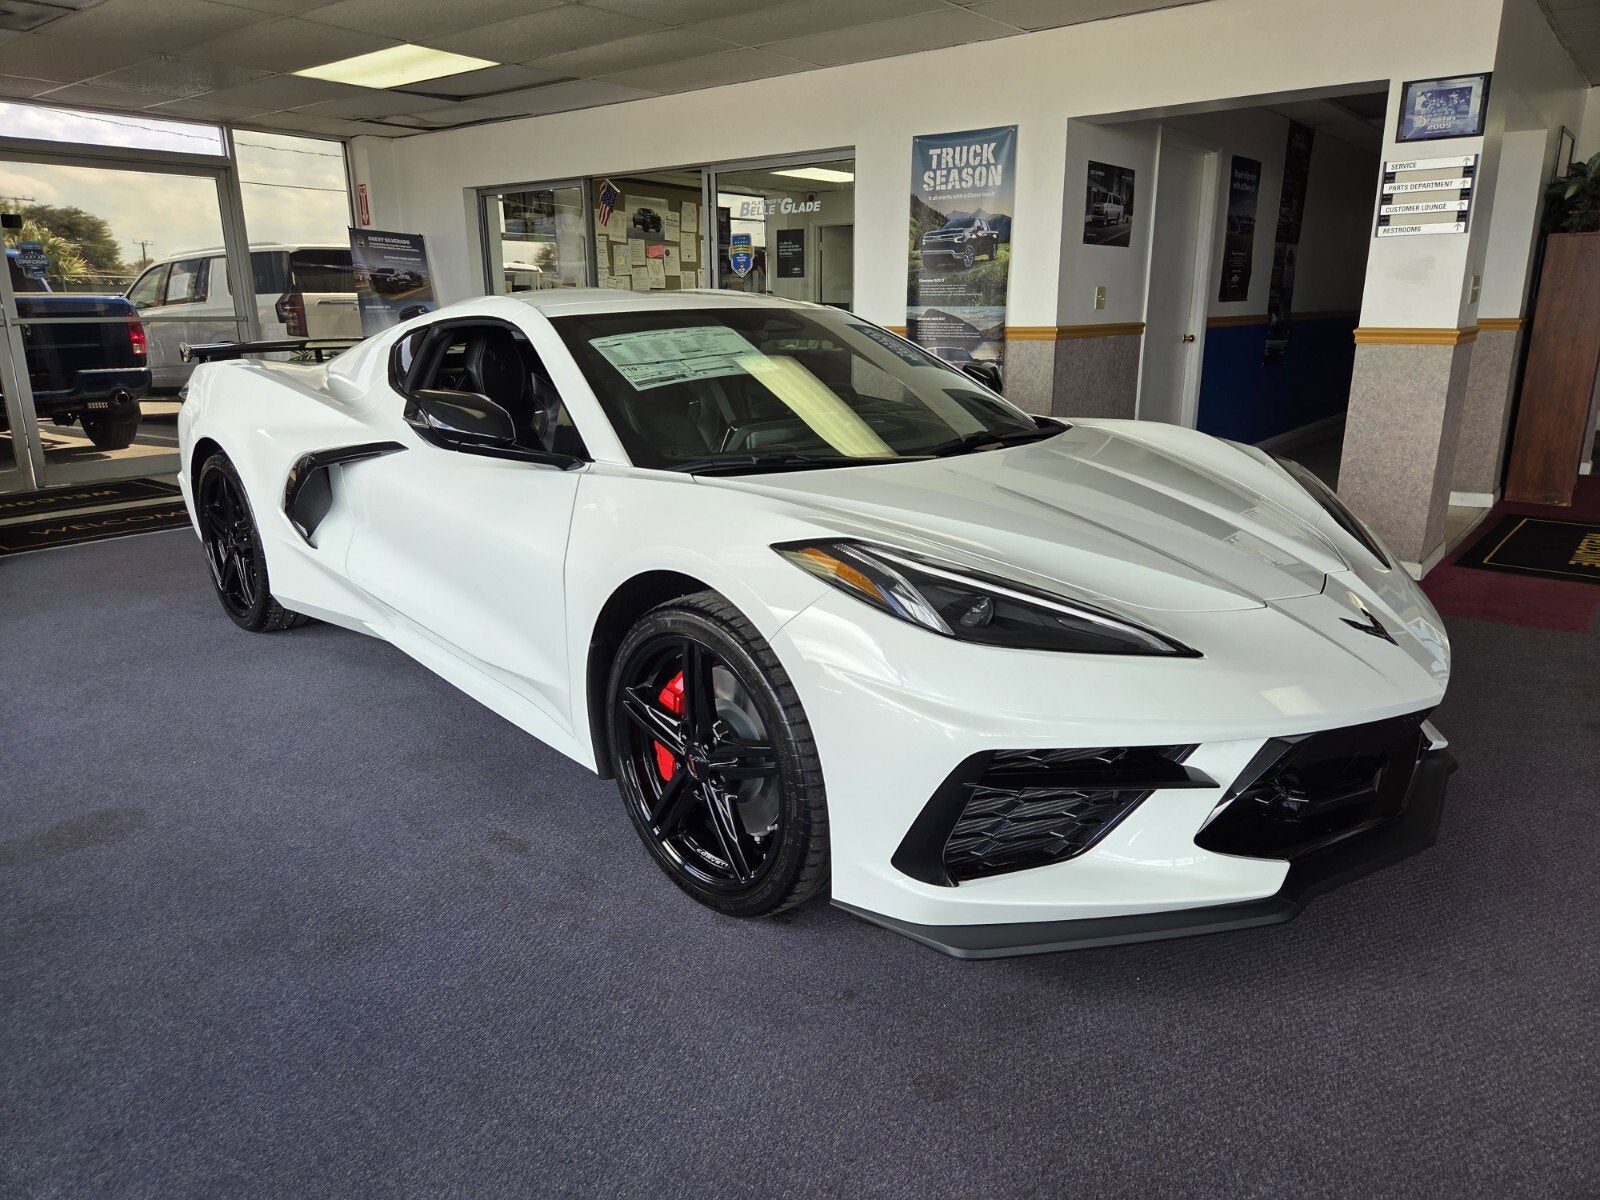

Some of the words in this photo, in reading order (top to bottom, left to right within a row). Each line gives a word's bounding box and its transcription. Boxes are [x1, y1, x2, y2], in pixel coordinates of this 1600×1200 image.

[929, 142, 997, 170] TRUCK
[1391, 162, 1417, 170] SERVICE
[923, 164, 1003, 191] SEASON
[1409, 181, 1453, 190] DEPARTMENT
[740, 201, 776, 217] BELLE
[780, 197, 821, 214] GLADE
[1385, 205, 1420, 213] CUSTOMER
[1421, 203, 1447, 211] LOUNGE
[1382, 226, 1422, 234] RESTROOMS
[29, 510, 190, 535] WELCOM
